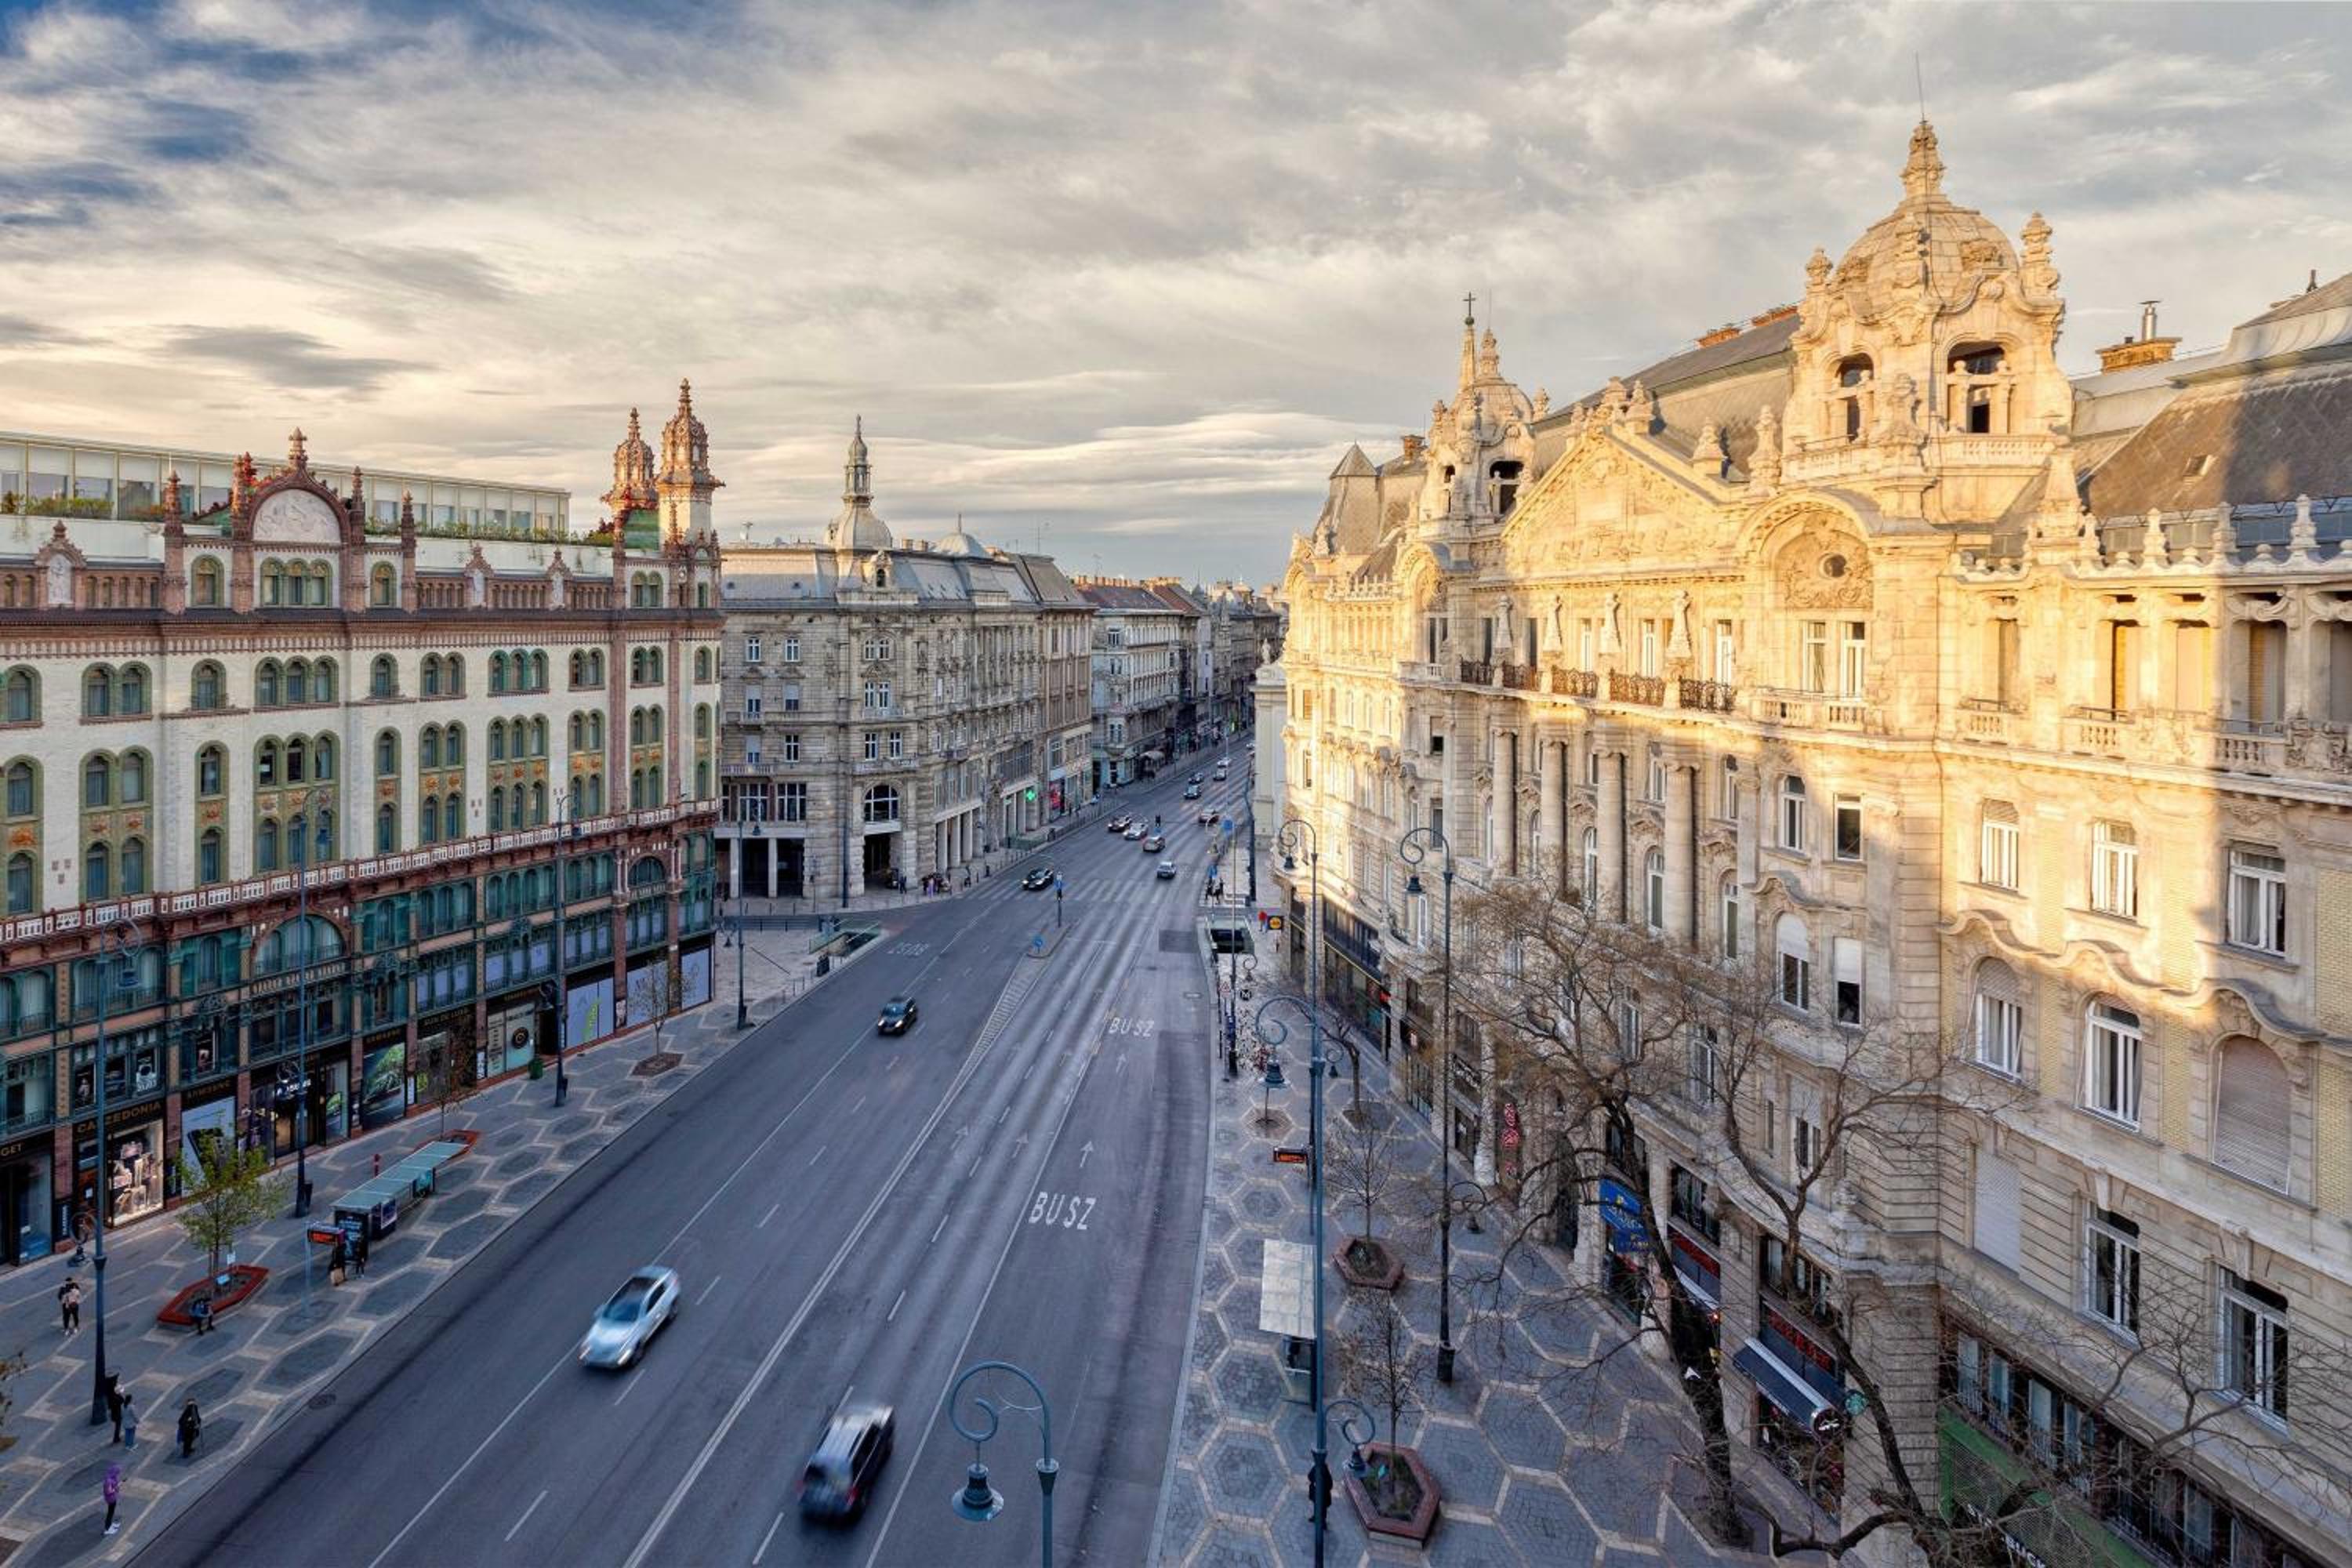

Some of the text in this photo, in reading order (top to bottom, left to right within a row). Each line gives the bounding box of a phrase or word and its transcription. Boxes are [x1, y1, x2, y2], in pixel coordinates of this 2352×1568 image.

[1109, 1016, 1154, 1036] BUSZ
[78, 1102, 162, 1134] CAZEDONIA
[1, 1144, 22, 1157] GET
[1029, 1191, 1096, 1230] BUSZ
